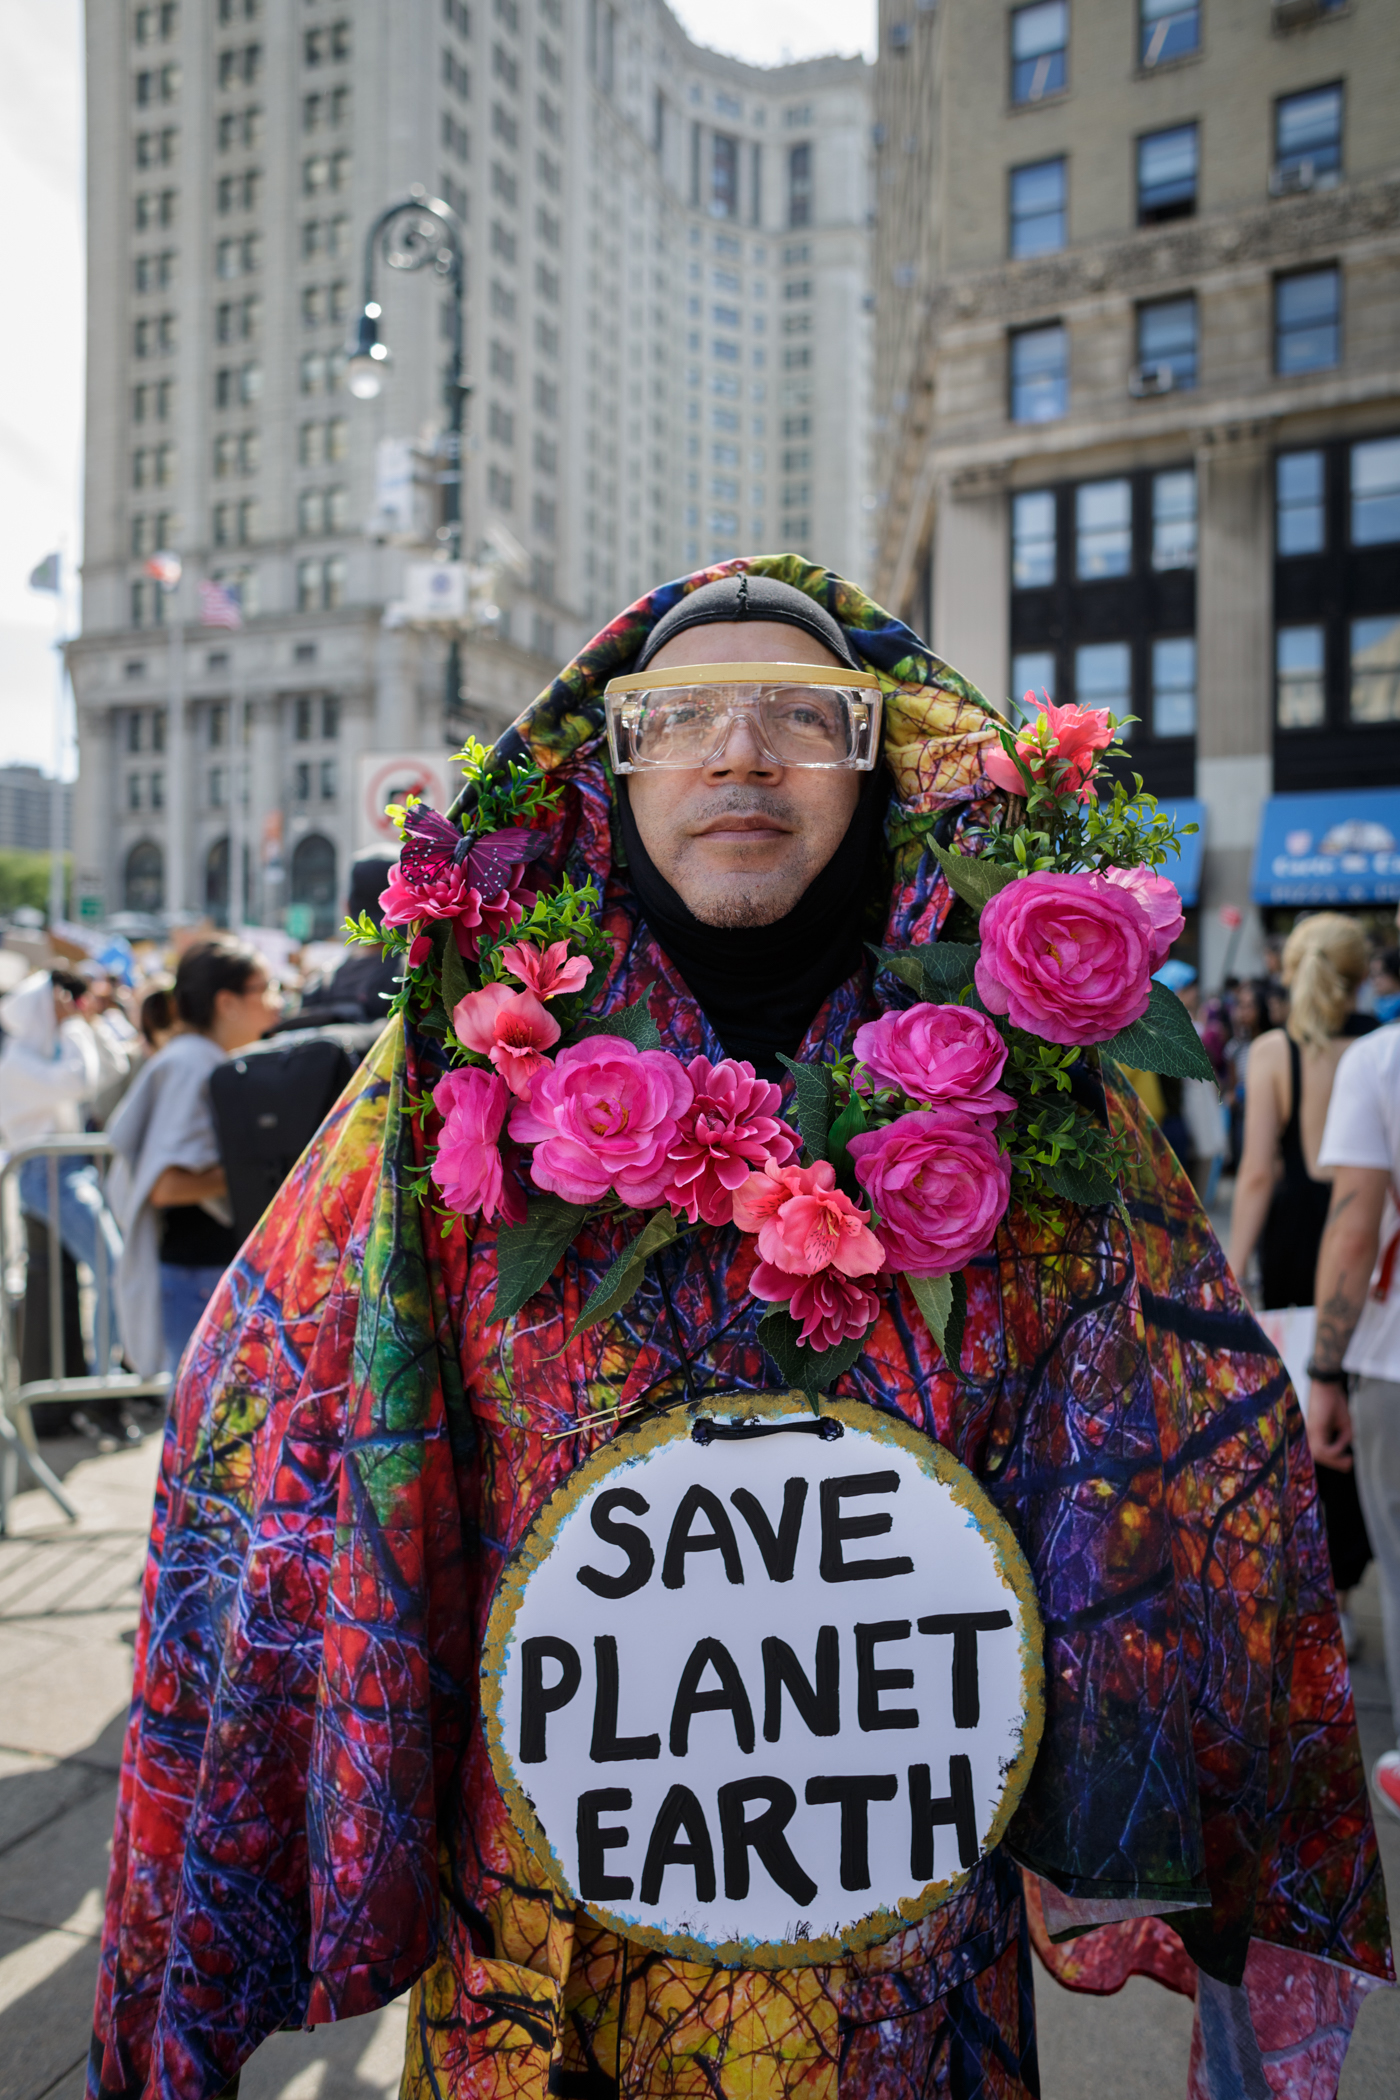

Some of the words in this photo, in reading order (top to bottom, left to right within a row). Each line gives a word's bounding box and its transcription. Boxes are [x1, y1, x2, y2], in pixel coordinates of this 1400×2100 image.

[576, 1470, 915, 1600] SAVE
[519, 1609, 1013, 1764] PLANET
[575, 1754, 981, 1907] EARTH
